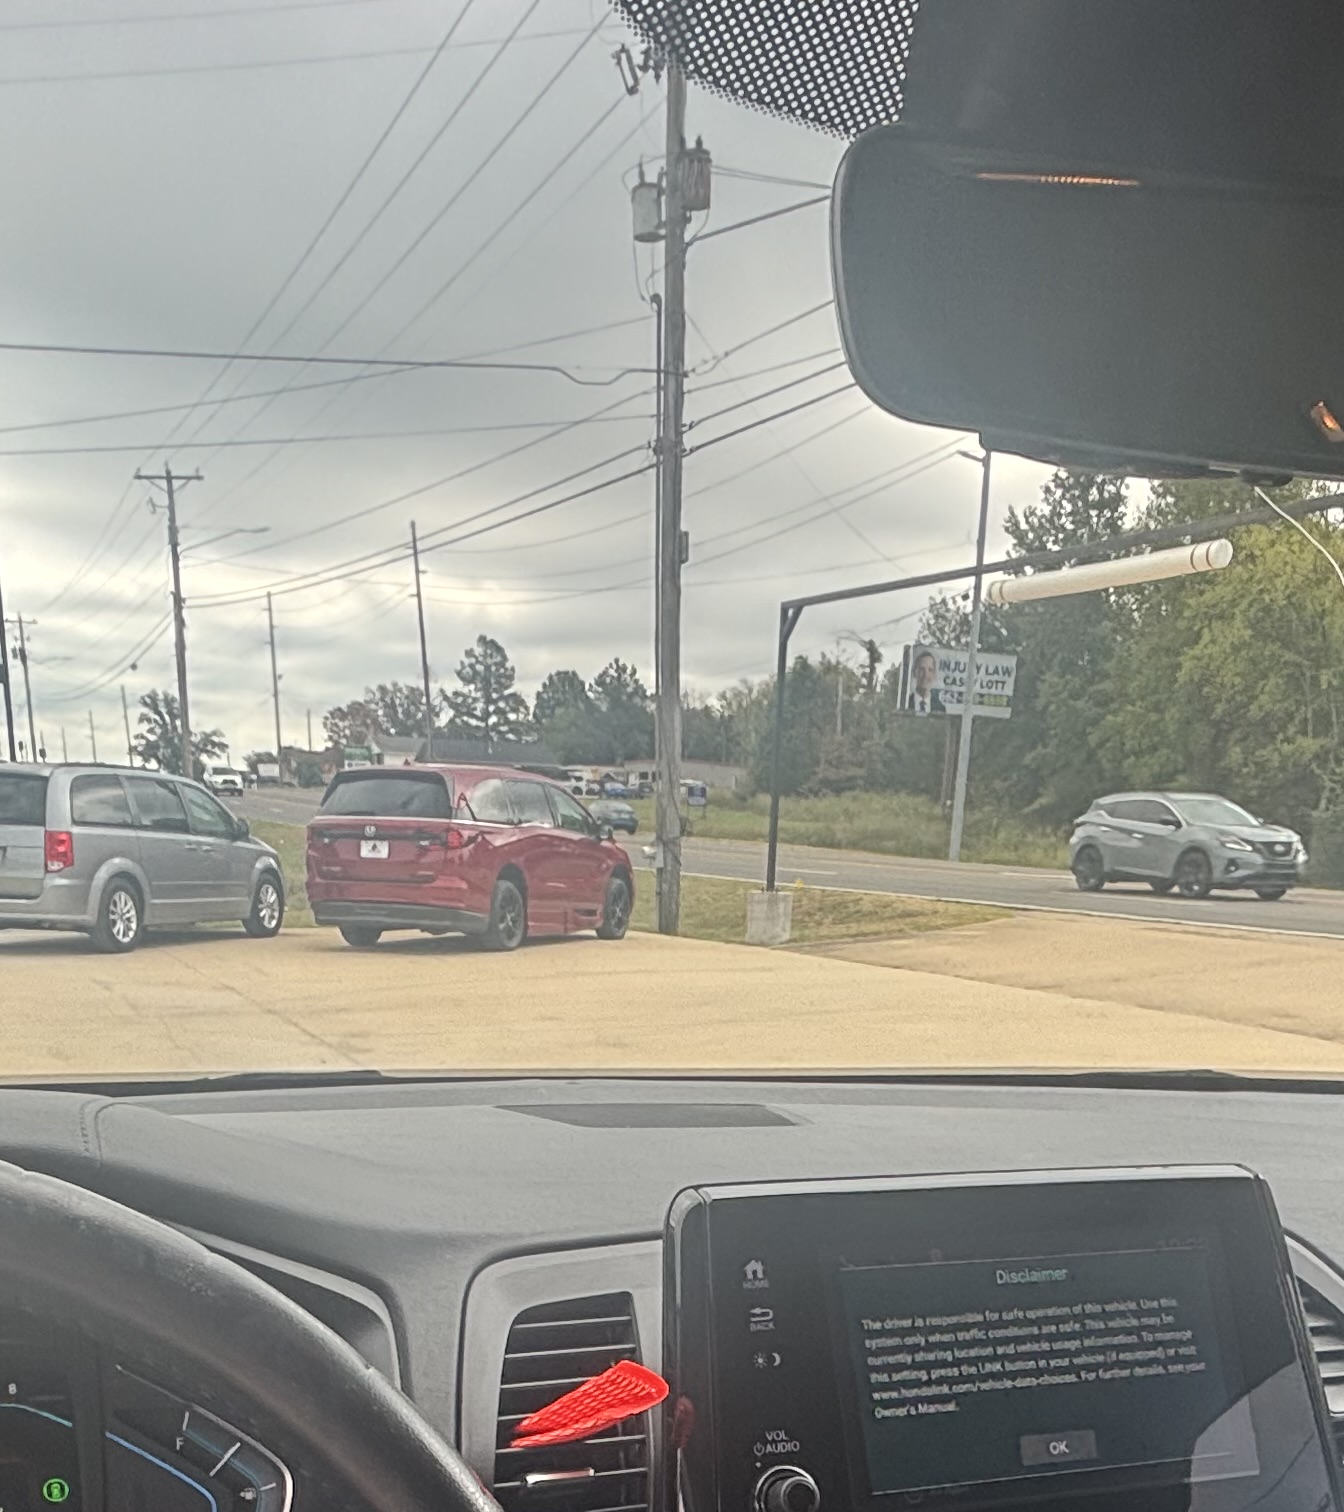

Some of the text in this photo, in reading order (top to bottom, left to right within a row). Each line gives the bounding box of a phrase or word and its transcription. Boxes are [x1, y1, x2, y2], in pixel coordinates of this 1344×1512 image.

[939, 659, 1012, 677] INJUY LAW
[943, 676, 1007, 690] CAS LOTT
[995, 1266, 1069, 1285] Disclaimer
[861, 1319, 882, 1330] The
[985, 1310, 1000, 1321] for
[1001, 1308, 1024, 1320] safe
[1072, 1303, 1083, 1314] of
[903, 1334, 925, 1347] only
[927, 1332, 955, 1343] when
[1041, 1324, 1057, 1334] are
[1140, 1316, 1160, 1327] may
[1161, 1313, 1175, 1324] be
[867, 1353, 913, 1366] currently
[996, 1343, 1016, 1355] and
[1140, 1331, 1153, 1342] To
[930, 1367, 959, 1380] press
[960, 1364, 978, 1376] the
[978, 1362, 1004, 1374] LINK
[1037, 1358, 1048, 1368] in
[1049, 1358, 1070, 1370] your
[1080, 1371, 1097, 1382] For
[8, 1383, 17, 1394] 8
[874, 1405, 916, 1419] Owner's
[176, 1437, 185, 1450] F
[766, 1430, 789, 1442] VOL
[766, 1441, 800, 1454] AUDIO
[1048, 1440, 1069, 1457] OK
